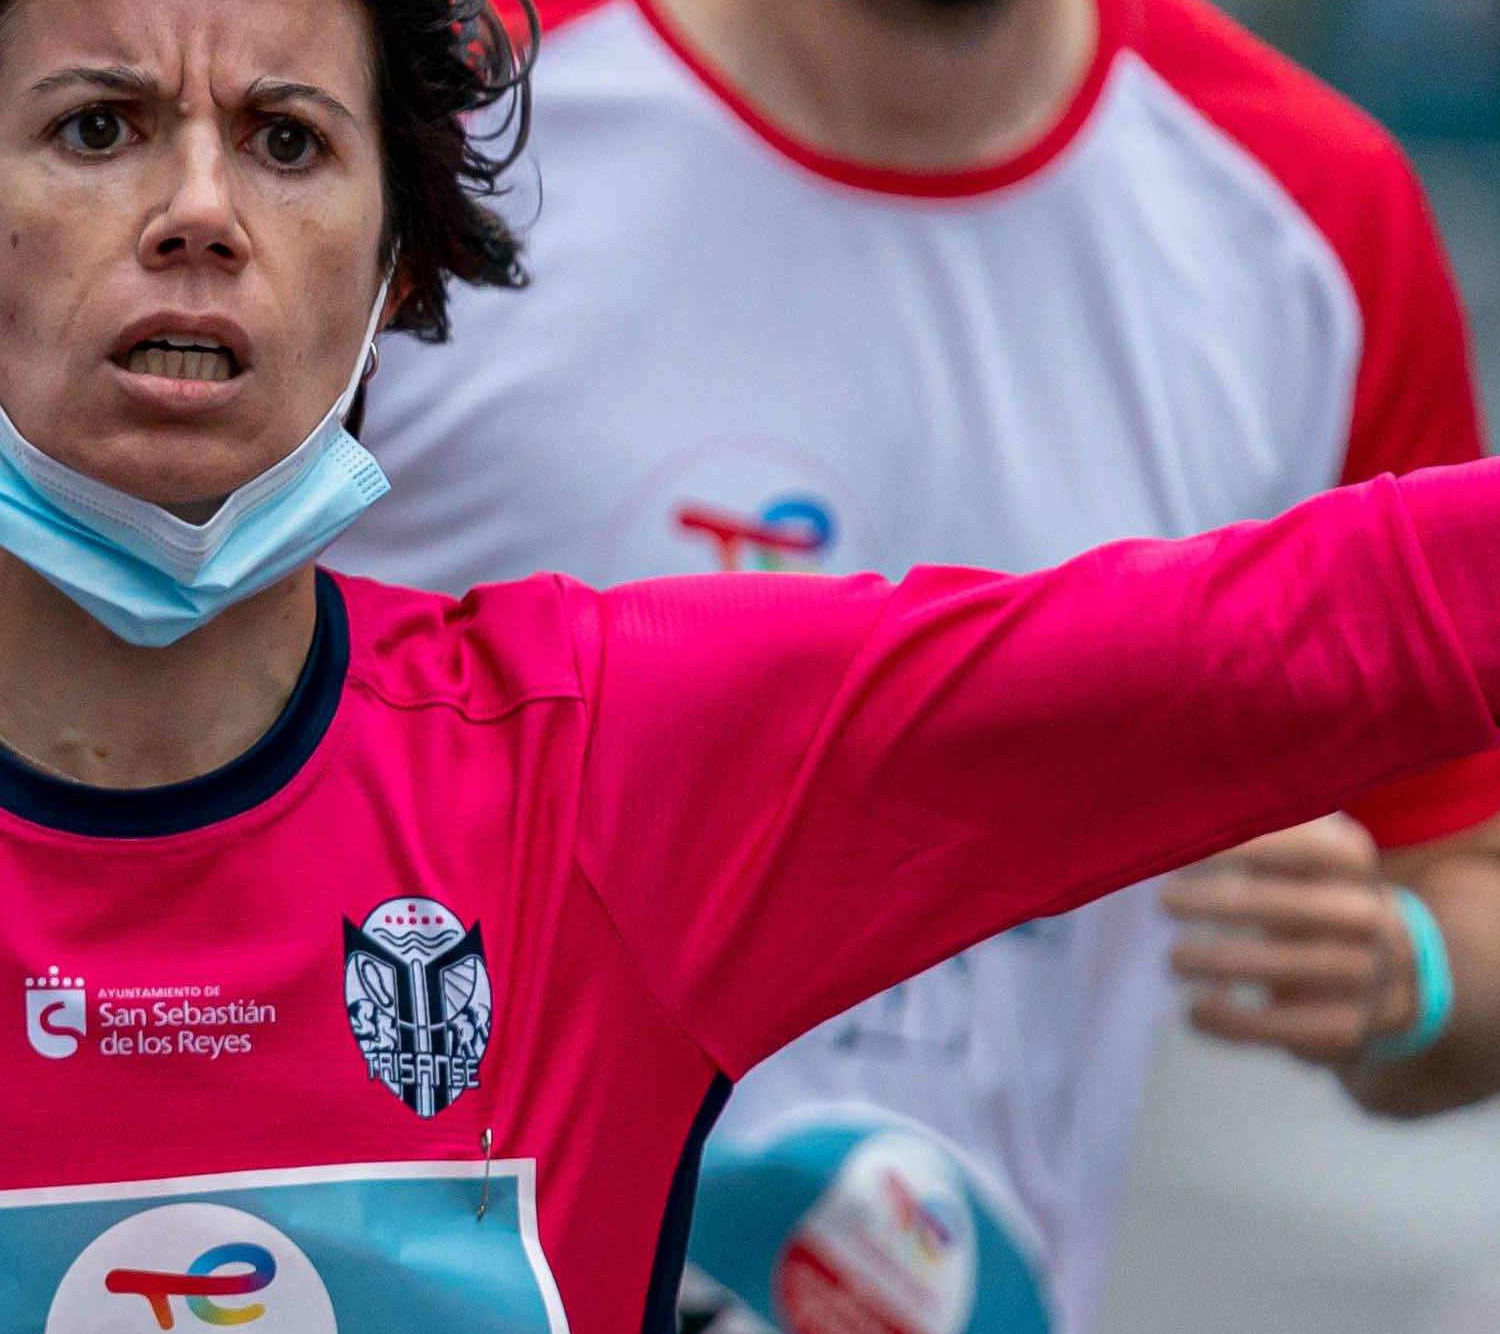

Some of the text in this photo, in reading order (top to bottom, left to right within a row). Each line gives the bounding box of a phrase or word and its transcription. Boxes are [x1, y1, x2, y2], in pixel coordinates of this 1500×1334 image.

[97, 985, 221, 999] AYUNTAMIENTO DE
[100, 999, 276, 1027] San Sebastián
[100, 1029, 252, 1060] de los Reyes
